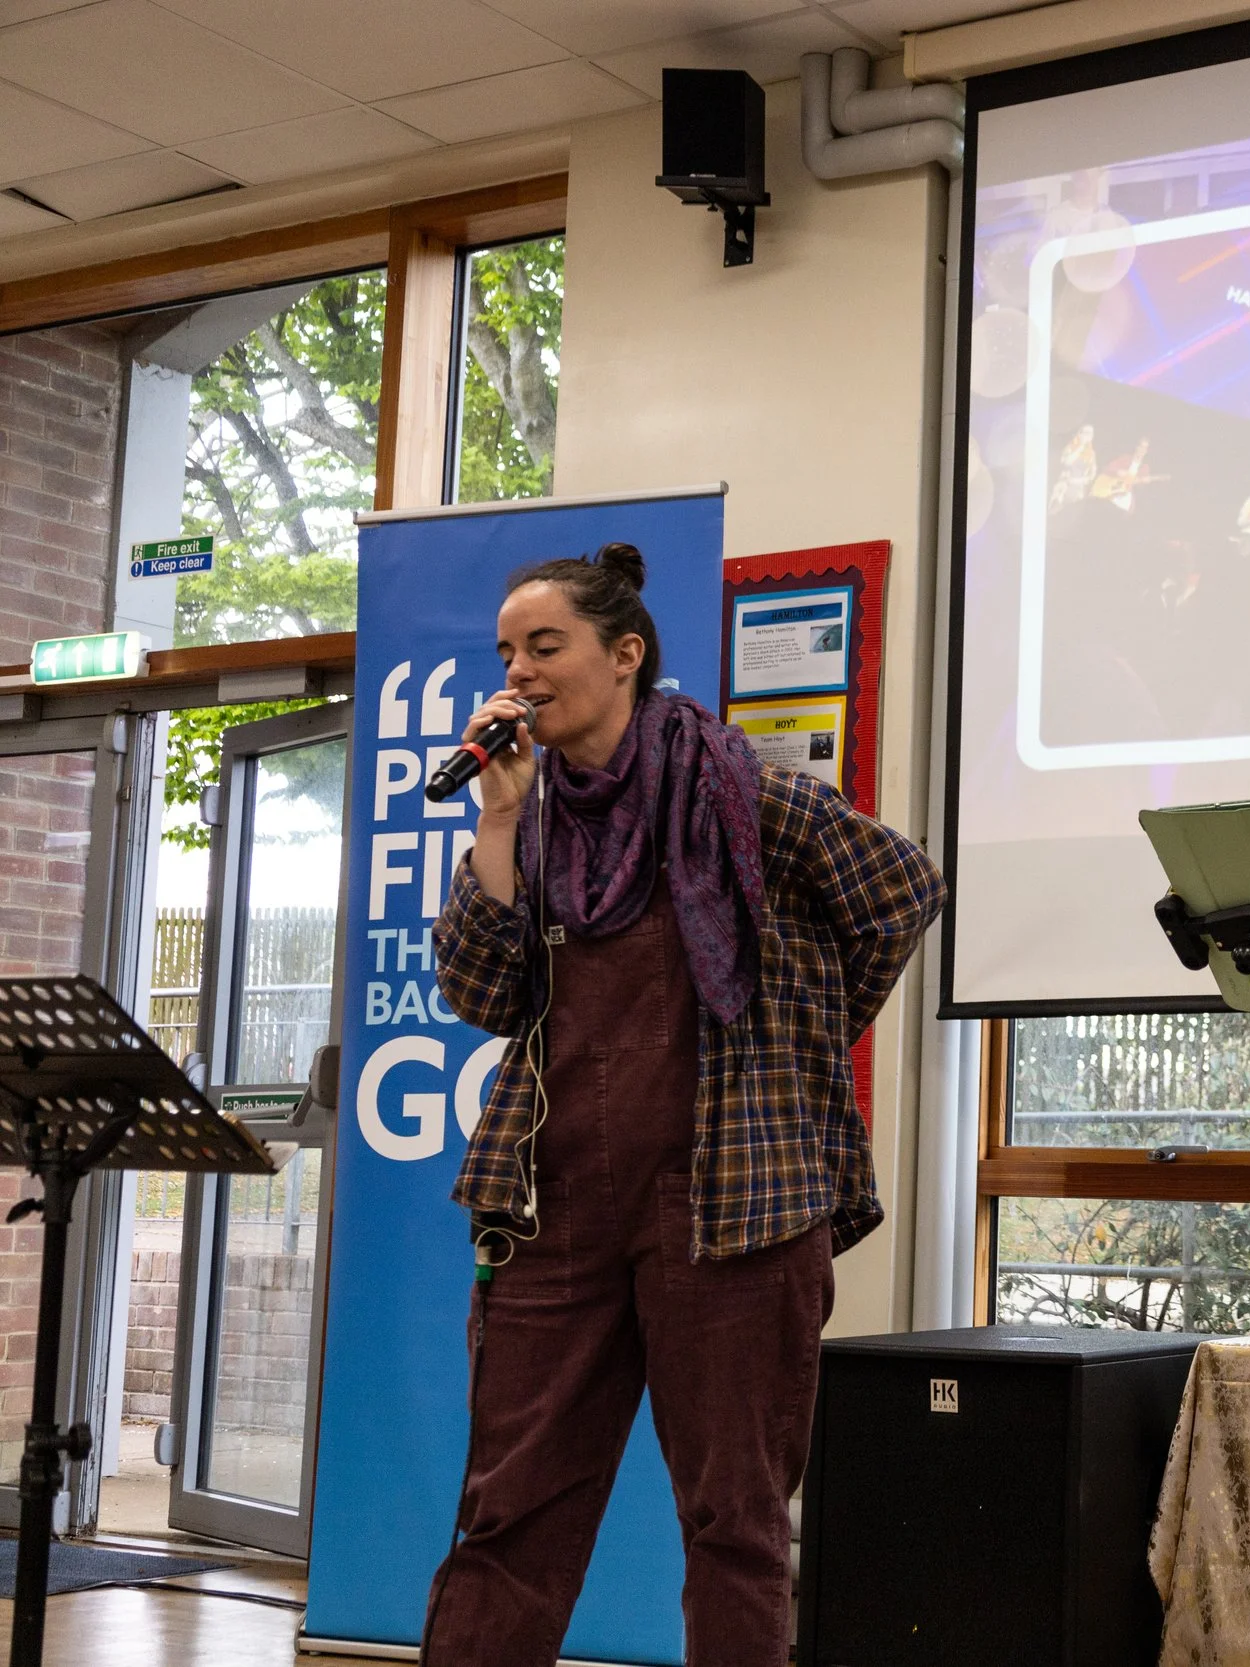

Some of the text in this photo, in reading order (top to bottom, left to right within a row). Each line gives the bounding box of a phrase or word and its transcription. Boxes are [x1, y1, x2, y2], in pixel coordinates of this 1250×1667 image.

[157, 540, 200, 557] Fire exit
[150, 557, 205, 573] Keep clear
[771, 608, 814, 619] HAMILTON
[775, 719, 798, 729] HOYT
[933, 1382, 956, 1402] HK
